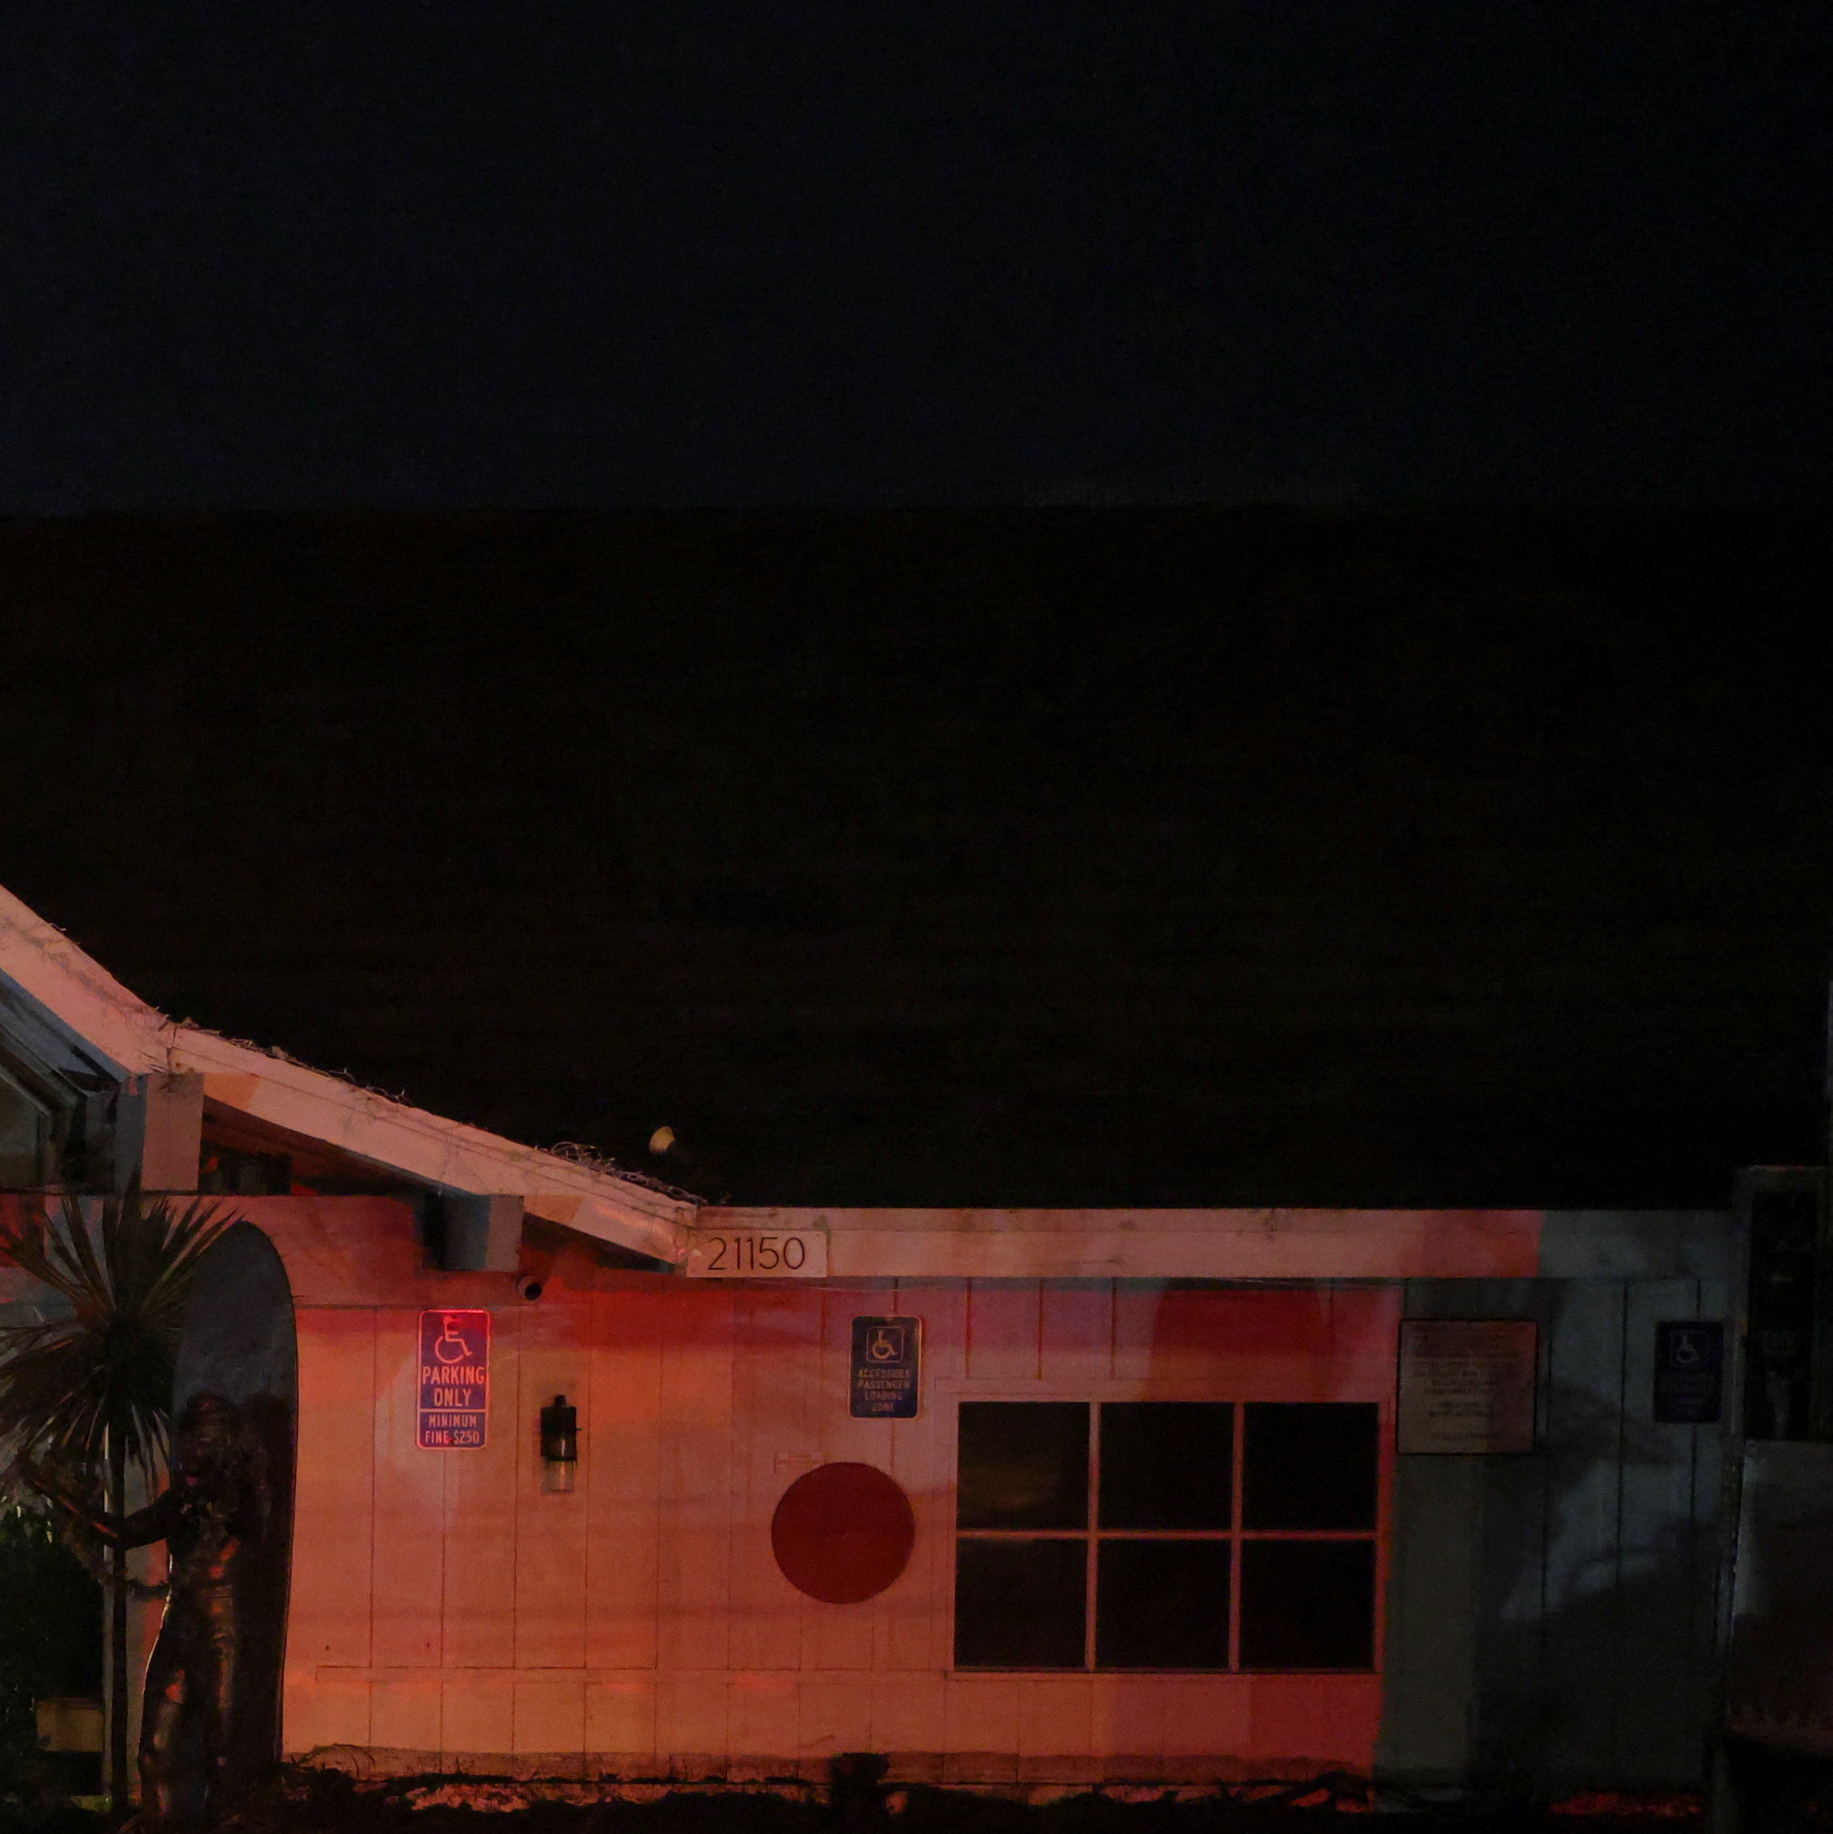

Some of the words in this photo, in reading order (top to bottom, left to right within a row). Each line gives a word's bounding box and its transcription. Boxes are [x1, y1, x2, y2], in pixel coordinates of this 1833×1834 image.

[707, 1236, 806, 1271] 21150
[422, 1366, 485, 1385] PARKING
[857, 1368, 910, 1378] ACCESSIBLE
[857, 1380, 910, 1389] PASSENGER
[434, 1388, 472, 1407] ONLY
[864, 1391, 903, 1401] LOADING
[871, 1402, 896, 1412] ZONE
[428, 1414, 477, 1427] MINIMUM
[424, 1430, 449, 1444] FINE
[453, 1429, 480, 1445] $250
